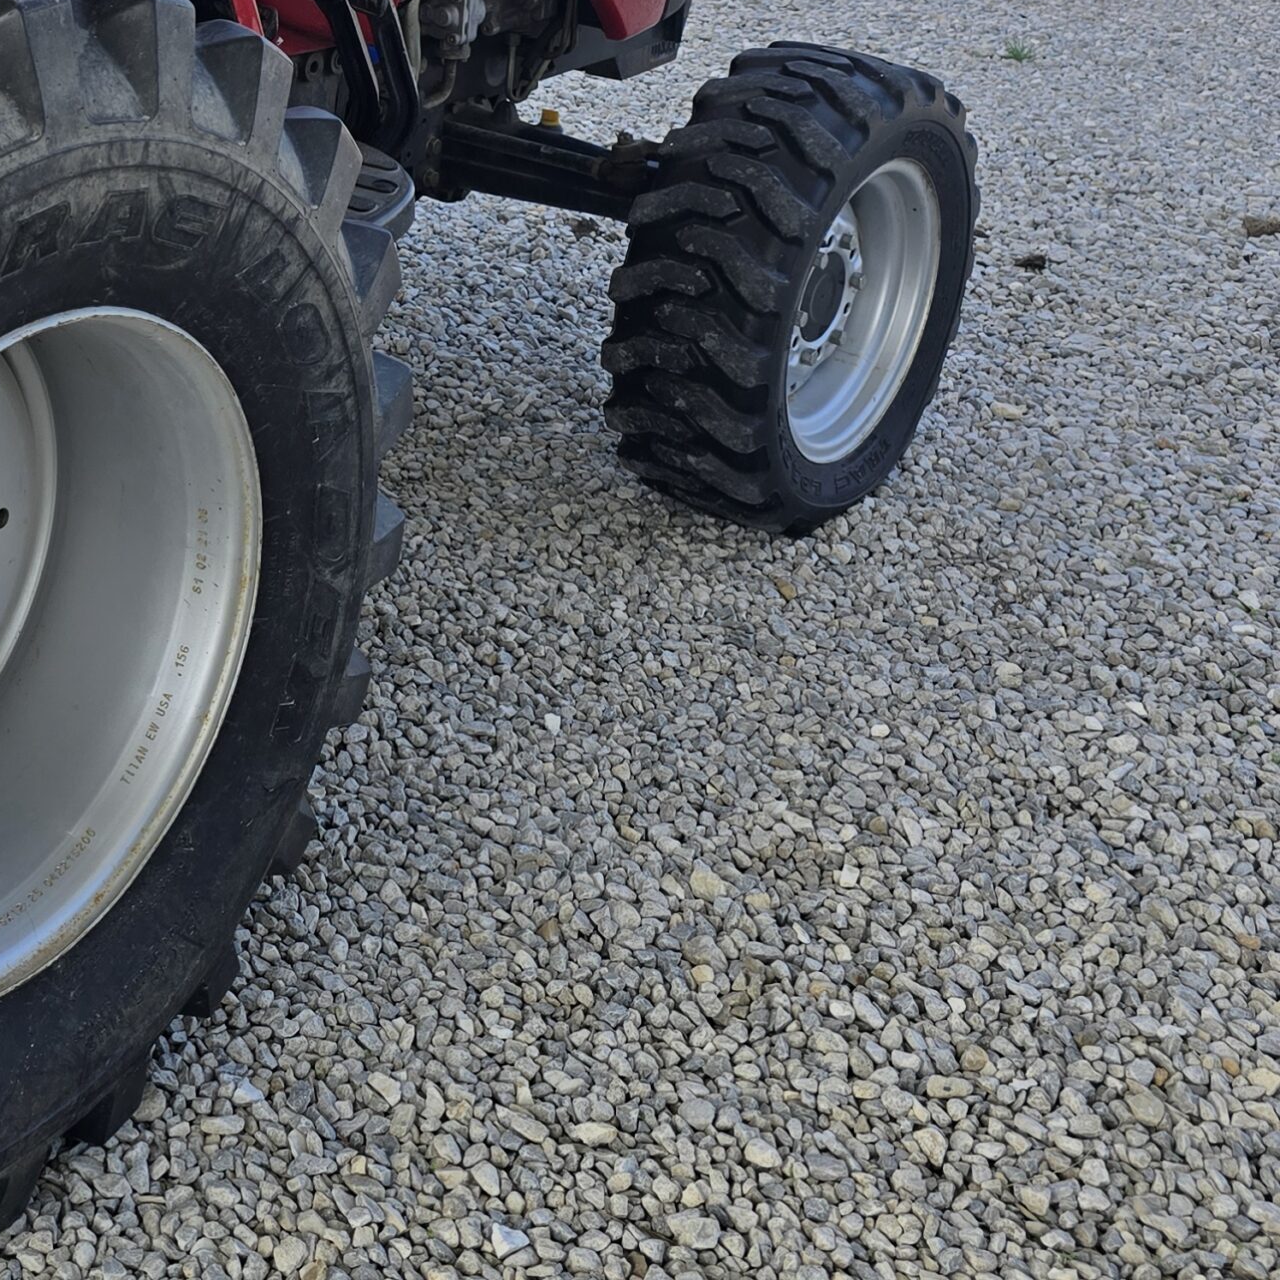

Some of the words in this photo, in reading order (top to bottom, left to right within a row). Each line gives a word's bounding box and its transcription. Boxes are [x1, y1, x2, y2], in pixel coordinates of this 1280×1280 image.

[120, 745, 149, 785] TITAN
[145, 722, 160, 741] EW
[156, 692, 173, 717] USA
